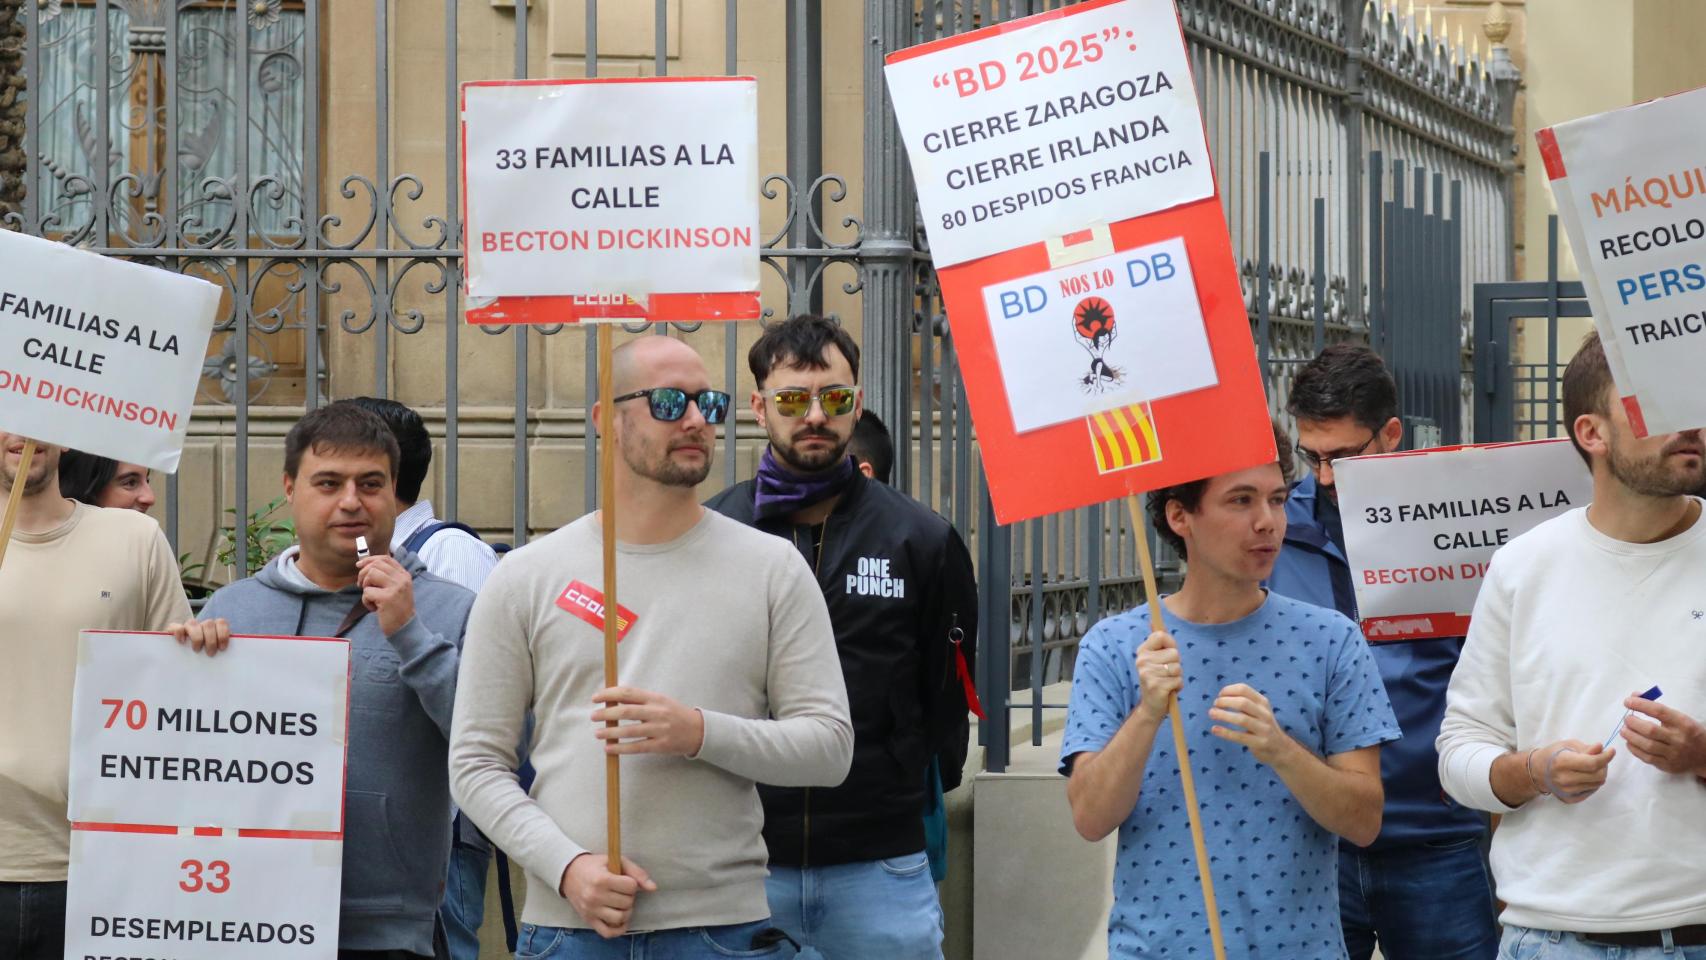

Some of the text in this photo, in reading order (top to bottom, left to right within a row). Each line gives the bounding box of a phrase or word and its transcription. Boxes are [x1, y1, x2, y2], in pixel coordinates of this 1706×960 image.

[923, 71, 1173, 153] CIERRE ZARAGOZA
[495, 143, 735, 169] 33 FAMILIAS A LA
[946, 115, 1169, 190] CIERRE IRLANDA
[571, 186, 660, 209] CALLE
[942, 150, 1192, 230] 80 DESPIDOS FRANCIA
[1591, 167, 1706, 217] MÁQUI
[482, 227, 751, 252] BECTON DICKINSON
[1600, 219, 1705, 259] RECOLO
[1000, 253, 1176, 319] BD NOS LO DB
[1616, 264, 1706, 305] PERS
[0, 292, 179, 356] FAMILIAS A LA
[23, 338, 105, 374] CALLE
[37, 380, 178, 430] DICKINSON
[1365, 490, 1571, 524] 33 FAMILIAS A LA
[1433, 528, 1509, 550] CALLE
[858, 556, 890, 578] ONE
[1363, 562, 1491, 585] BECTON DI
[846, 574, 905, 598] PUNCH
[101, 698, 318, 737] 70 MILLONES
[100, 754, 314, 785] ENTERRADOS
[178, 859, 231, 893] 33
[90, 916, 315, 945] DESEMPLEADOS
